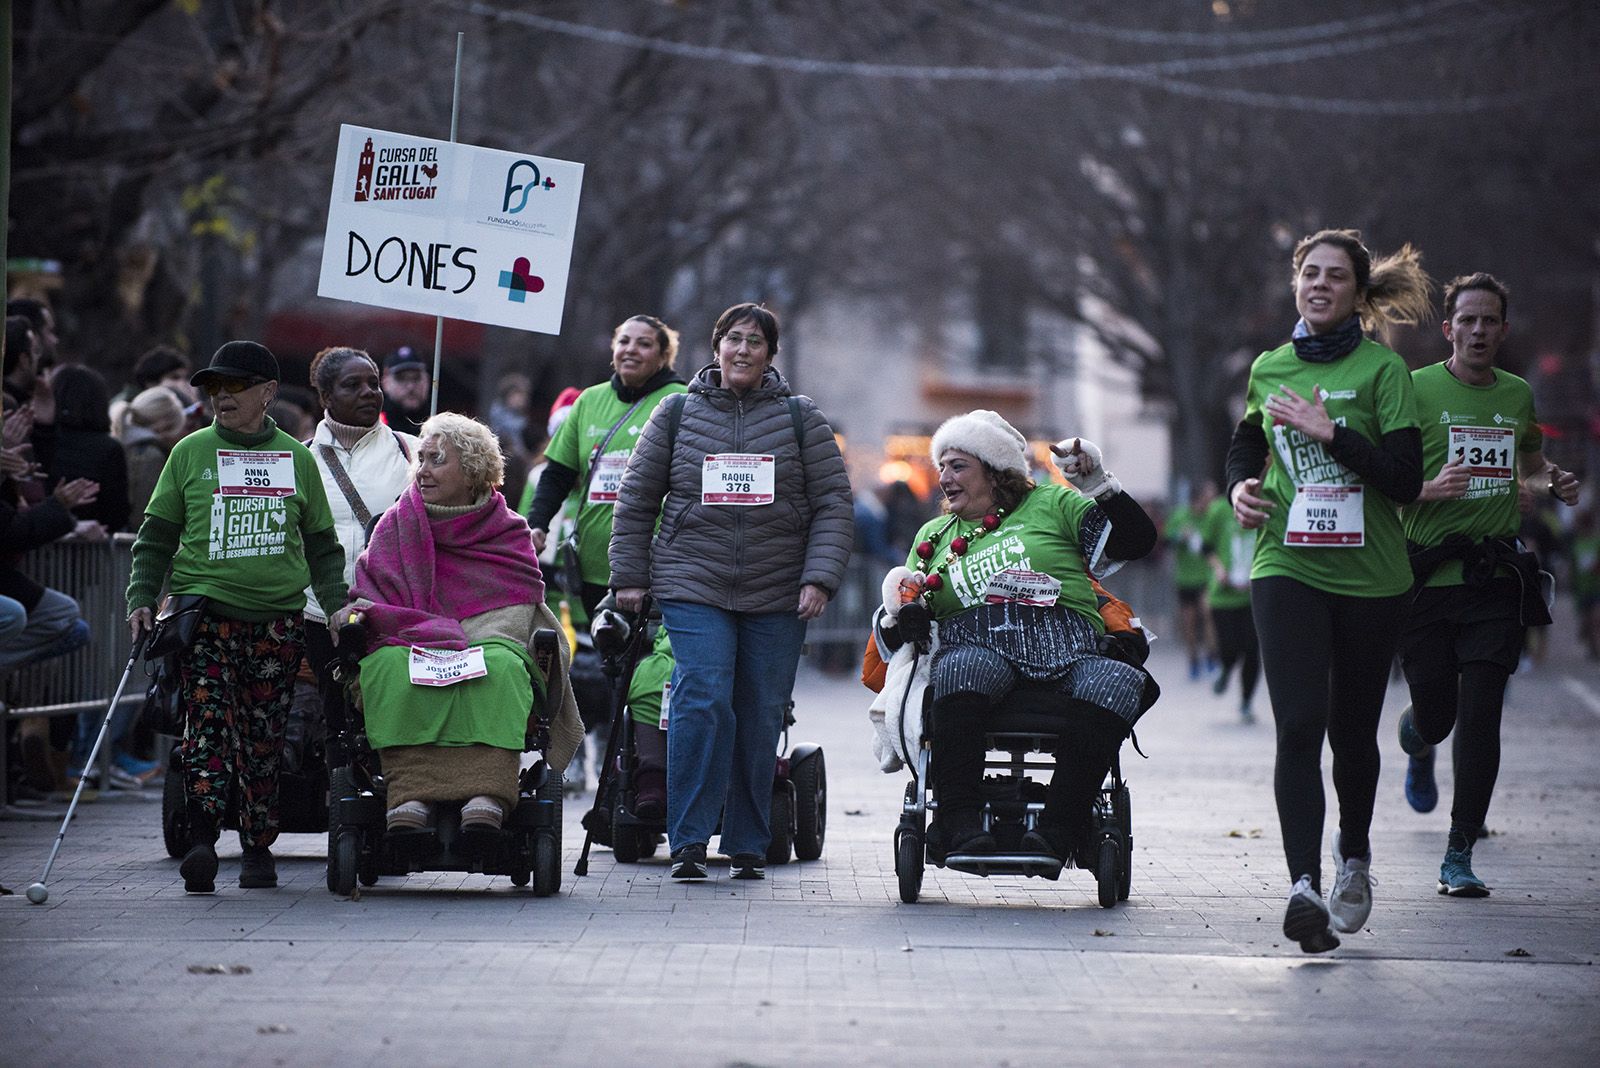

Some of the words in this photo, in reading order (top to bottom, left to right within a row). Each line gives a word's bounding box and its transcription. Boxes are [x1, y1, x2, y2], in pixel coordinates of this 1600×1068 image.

[379, 147, 416, 162] CURSA
[419, 147, 438, 161] DEL
[375, 165, 421, 185] GALL
[373, 187, 402, 200] SANT
[403, 186, 437, 199] CUGAT
[345, 230, 478, 294] DONES
[1295, 442, 1335, 471] GAL
[1455, 446, 1508, 467] 1341
[244, 468, 269, 477] ANNA
[721, 472, 755, 482] RAQUEL
[244, 477, 271, 487] 390
[603, 482, 619, 491] 50
[726, 482, 751, 492] 378
[230, 498, 265, 513] CURSA
[268, 497, 286, 510] DEL
[1306, 508, 1338, 518] NURIA
[228, 512, 271, 535] GALL
[1307, 519, 1336, 531] 763
[226, 534, 254, 549] SANT
[254, 531, 286, 546] CUGAT
[208, 551, 216, 560] 31
[216, 550, 225, 560] DE
[226, 547, 259, 558] DESEMBRE
[260, 547, 268, 555] DE
[269, 546, 285, 555] 2023
[965, 543, 1000, 566] CURSA
[1001, 535, 1020, 550] DEL
[967, 549, 1012, 585] GALL
[989, 581, 1018, 593] MARIA
[425, 662, 469, 673] JOSEFINA
